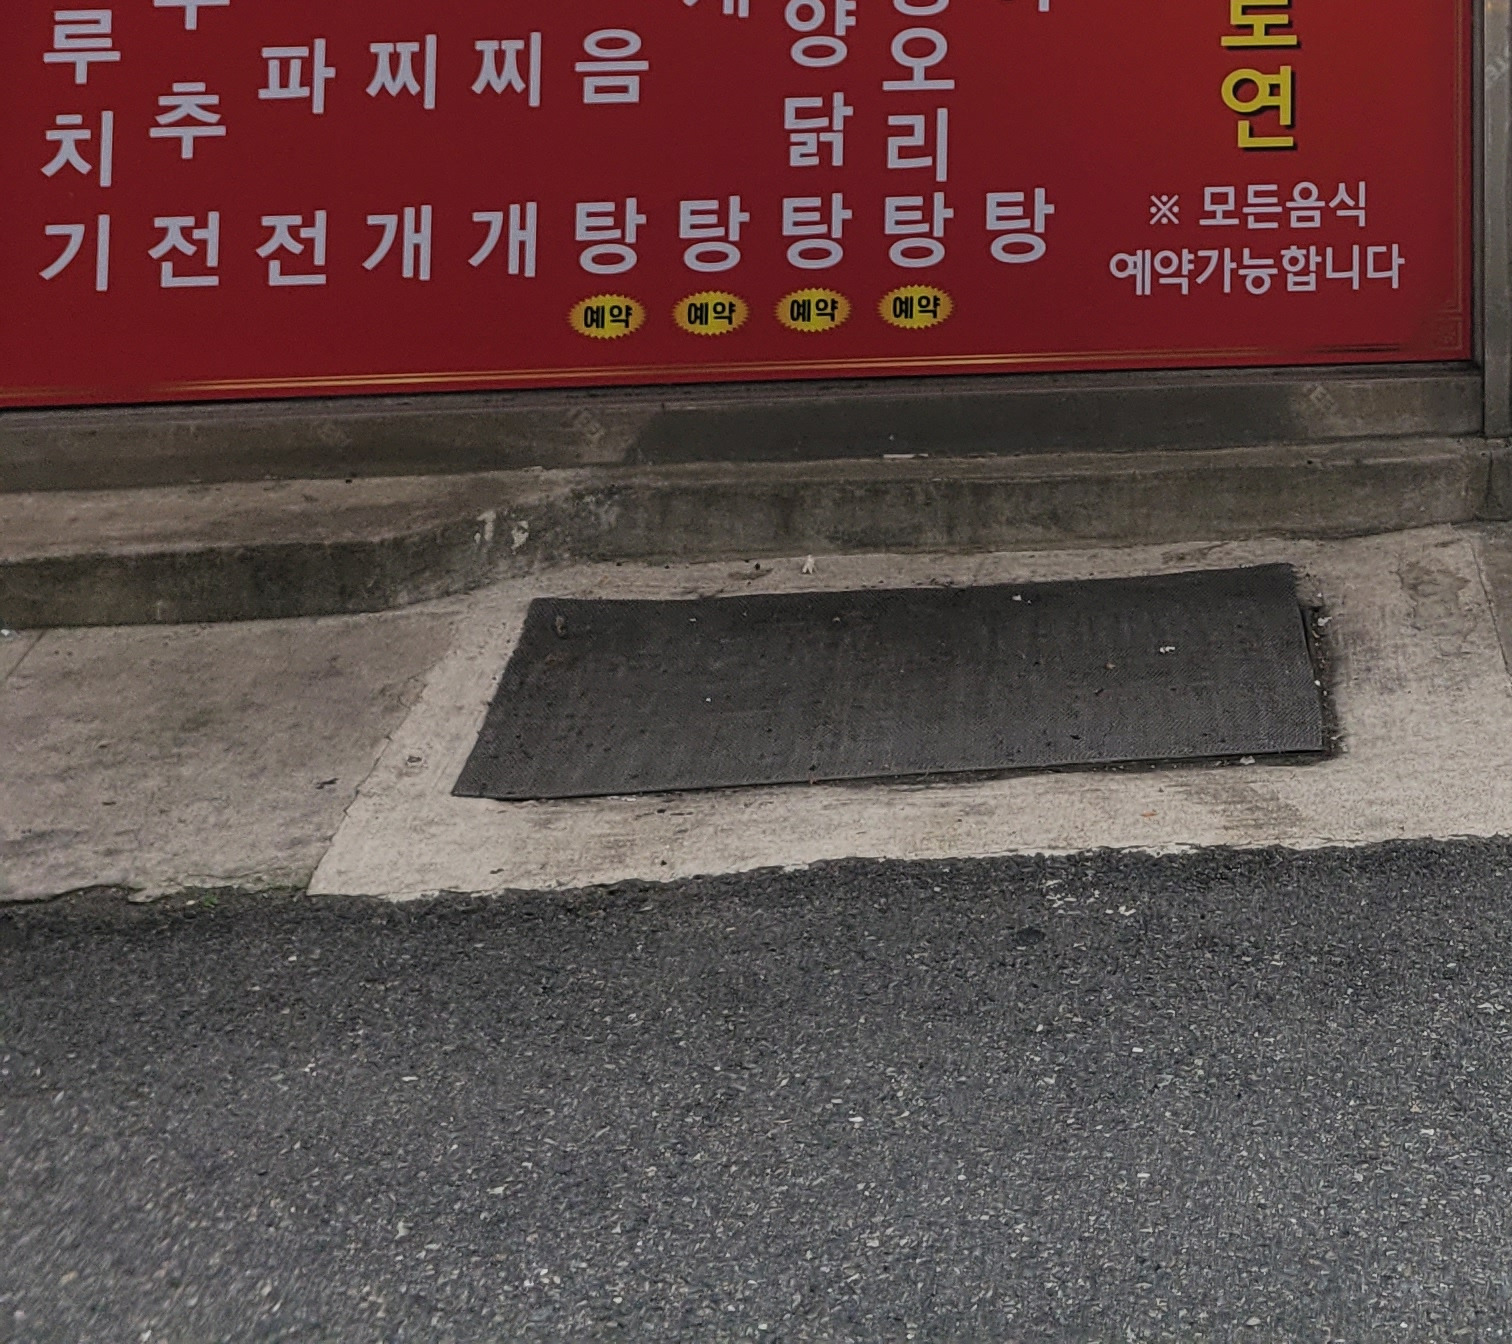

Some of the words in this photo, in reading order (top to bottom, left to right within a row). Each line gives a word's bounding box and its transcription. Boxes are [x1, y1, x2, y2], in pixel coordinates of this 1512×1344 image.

[1199, 180, 1368, 230] 모든음식
[1109, 243, 1406, 296] 예약가능합니다
[583, 304, 633, 329] 예약
[687, 301, 736, 326] 예약
[789, 298, 839, 322] 예약
[892, 295, 941, 320] 예약
